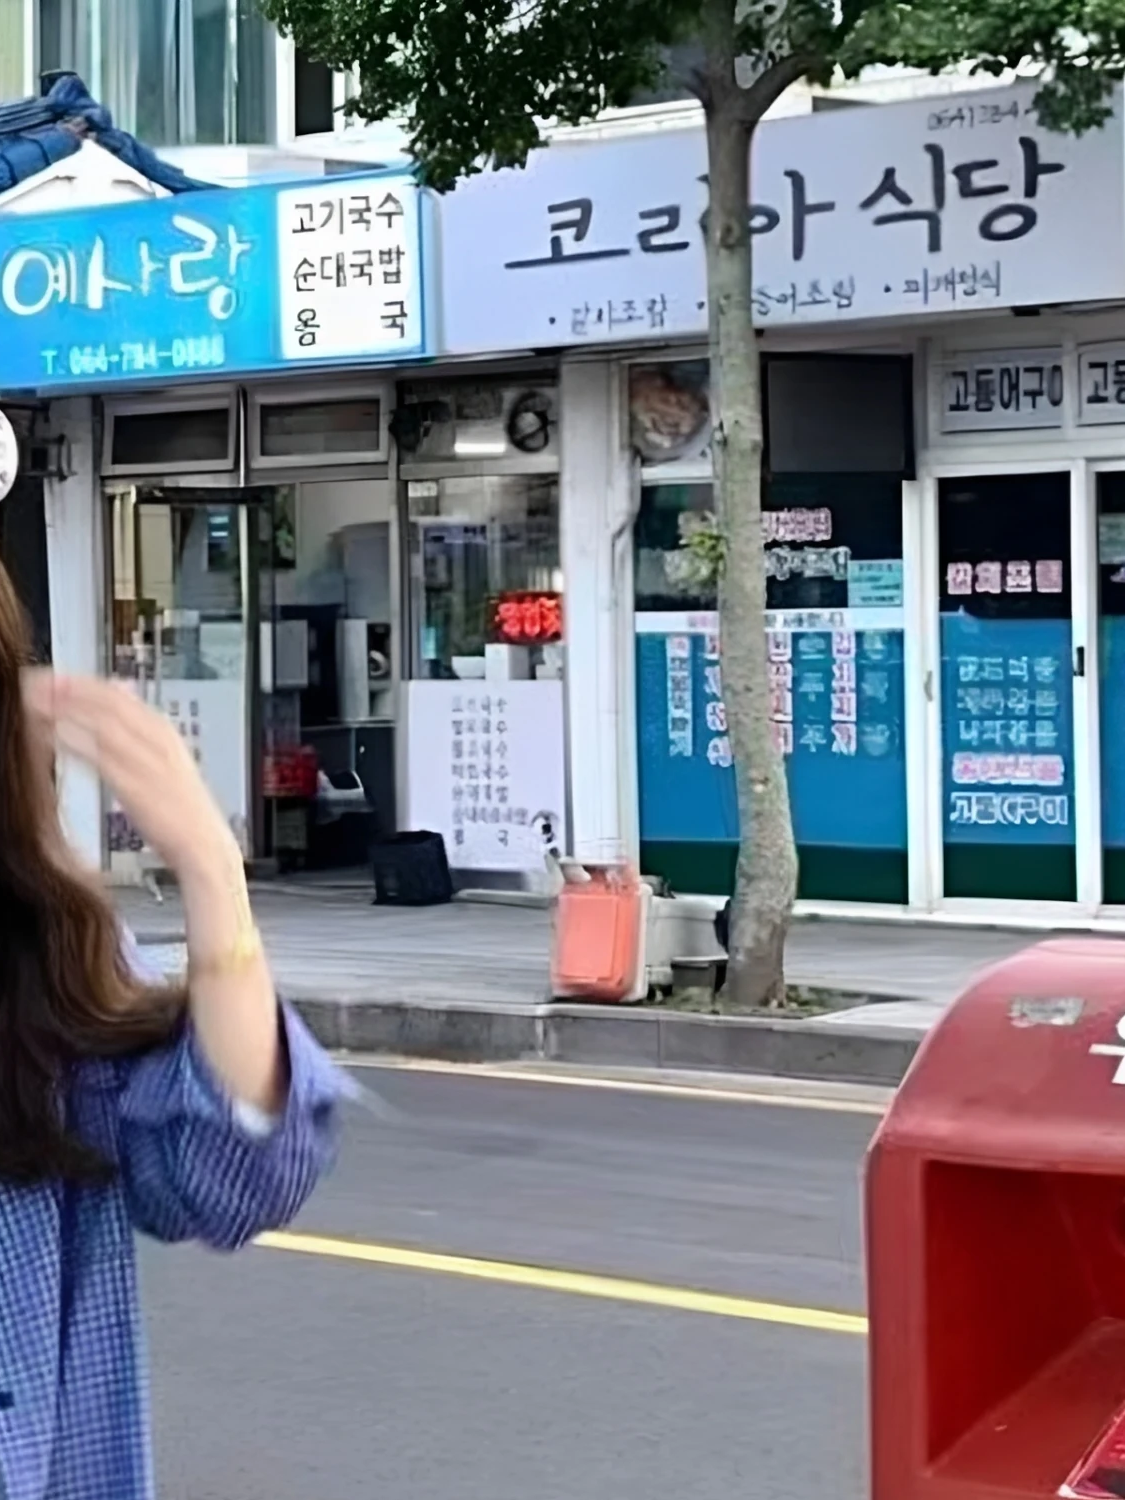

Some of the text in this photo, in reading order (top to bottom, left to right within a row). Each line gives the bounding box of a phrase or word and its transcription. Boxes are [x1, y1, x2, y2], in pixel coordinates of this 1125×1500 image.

[291, 192, 405, 234] 고기국수
[859, 136, 1065, 253] 식당
[2, 214, 251, 320] 예사랑
[293, 244, 406, 292] 순대국밥
[380, 300, 408, 339] 국
